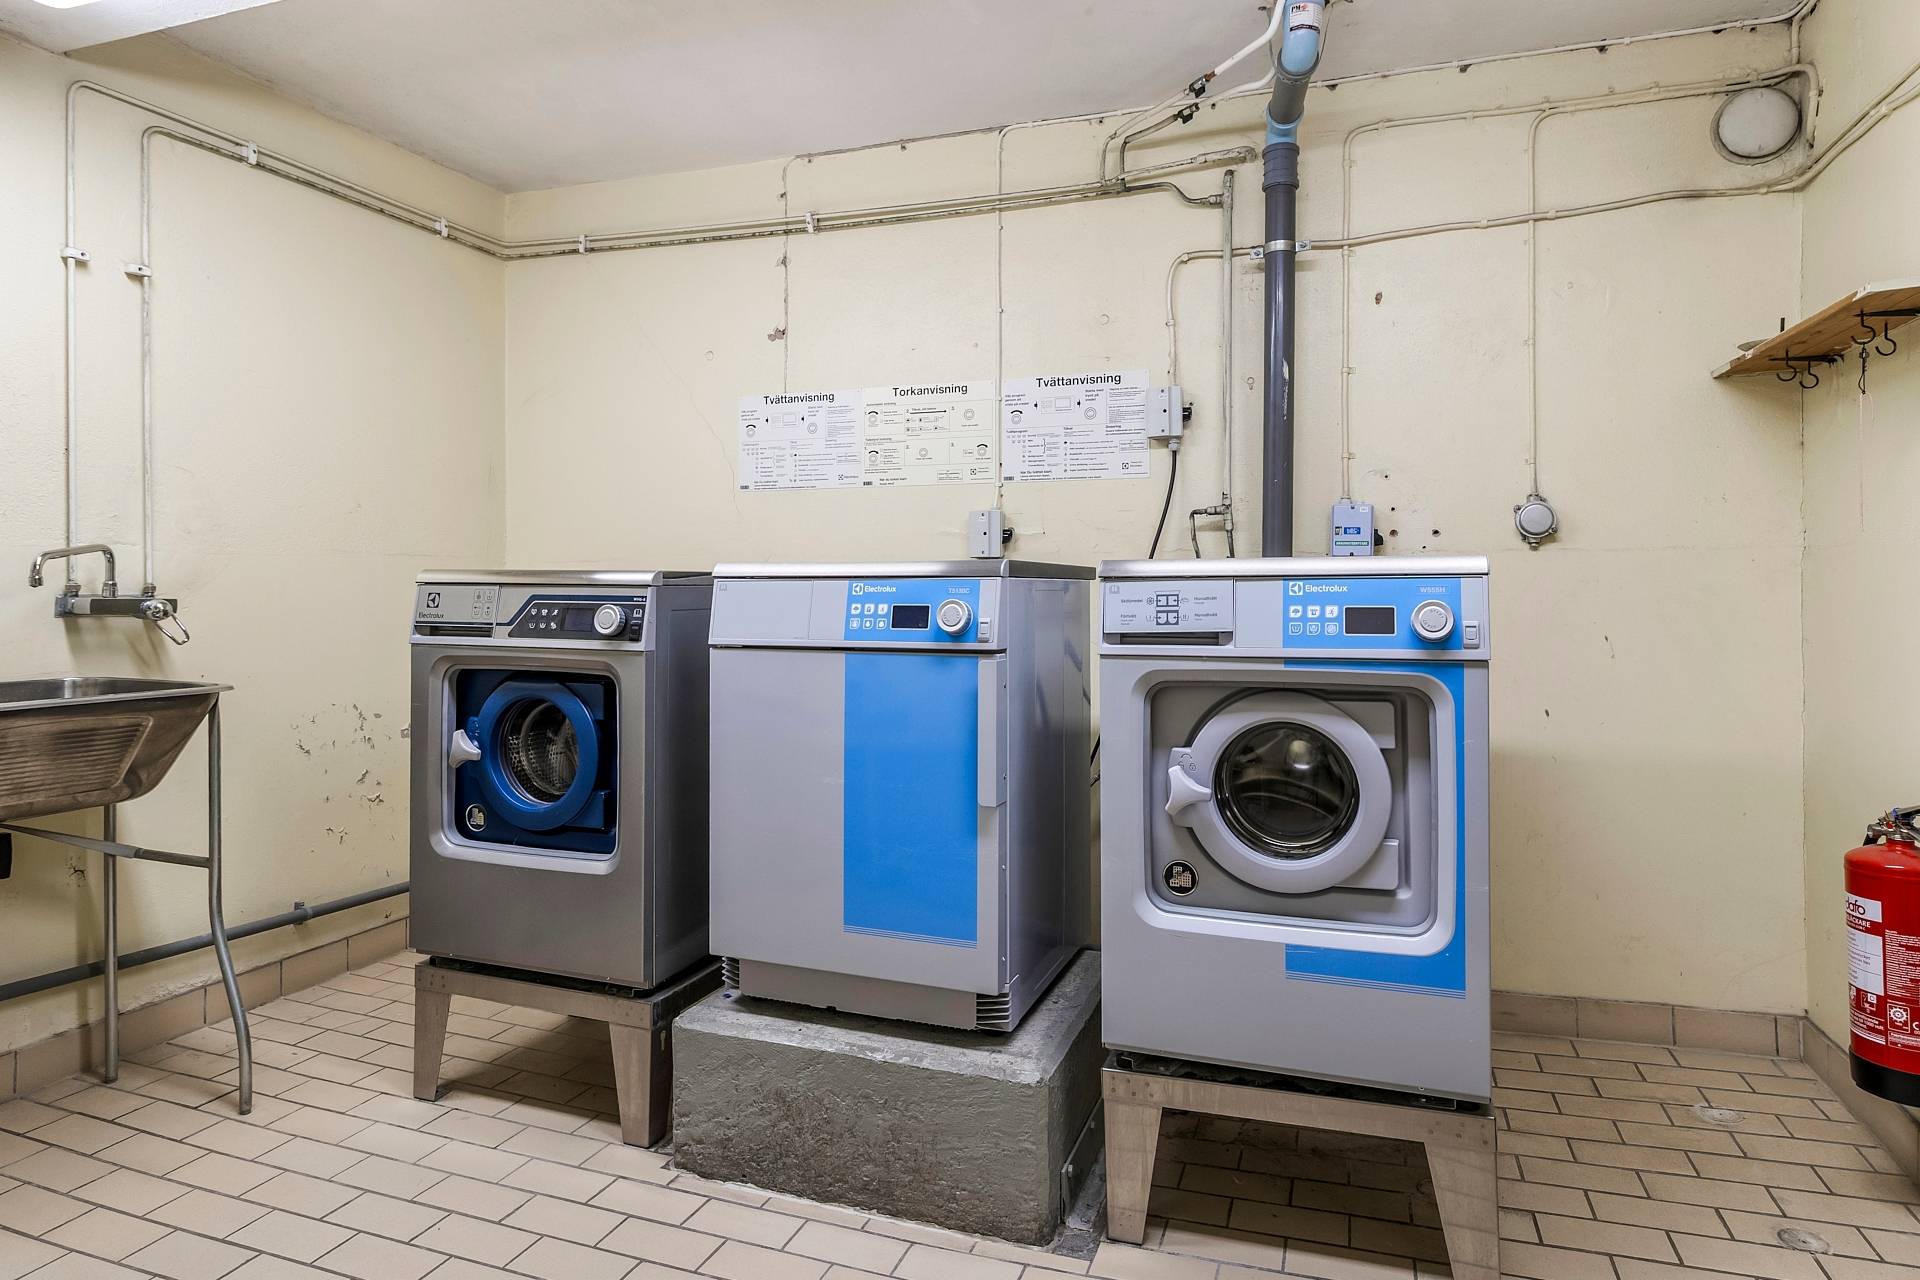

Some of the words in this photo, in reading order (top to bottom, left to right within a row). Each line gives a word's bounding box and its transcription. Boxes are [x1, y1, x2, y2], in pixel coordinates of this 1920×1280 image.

[1035, 373, 1122, 388] Tvättanvisning
[893, 384, 968, 397] Torkanvisning
[763, 392, 835, 405] Tvättanvisning
[864, 585, 897, 593] Electrolux
[1305, 584, 1348, 593] Electrolux
[418, 611, 445, 619] Electrolux
